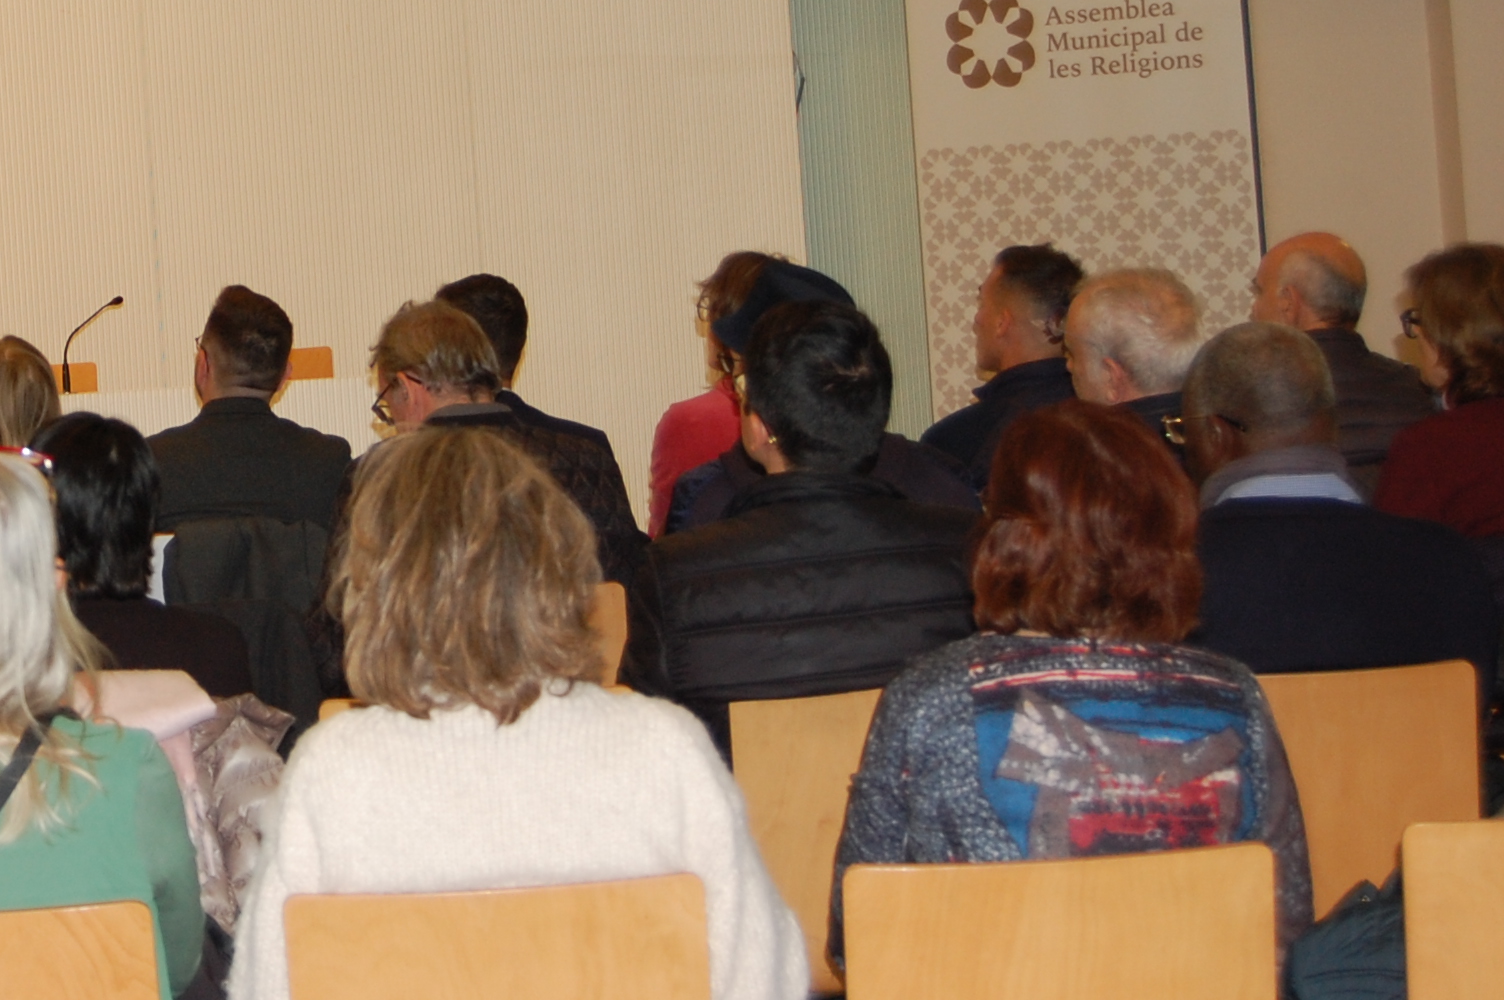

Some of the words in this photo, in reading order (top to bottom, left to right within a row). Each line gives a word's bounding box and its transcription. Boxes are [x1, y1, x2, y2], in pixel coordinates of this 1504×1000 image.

[1046, 24, 1166, 52] Municipal
[1175, 21, 1204, 42] de
[1048, 59, 1082, 79] les
[1090, 52, 1204, 79] Religions
